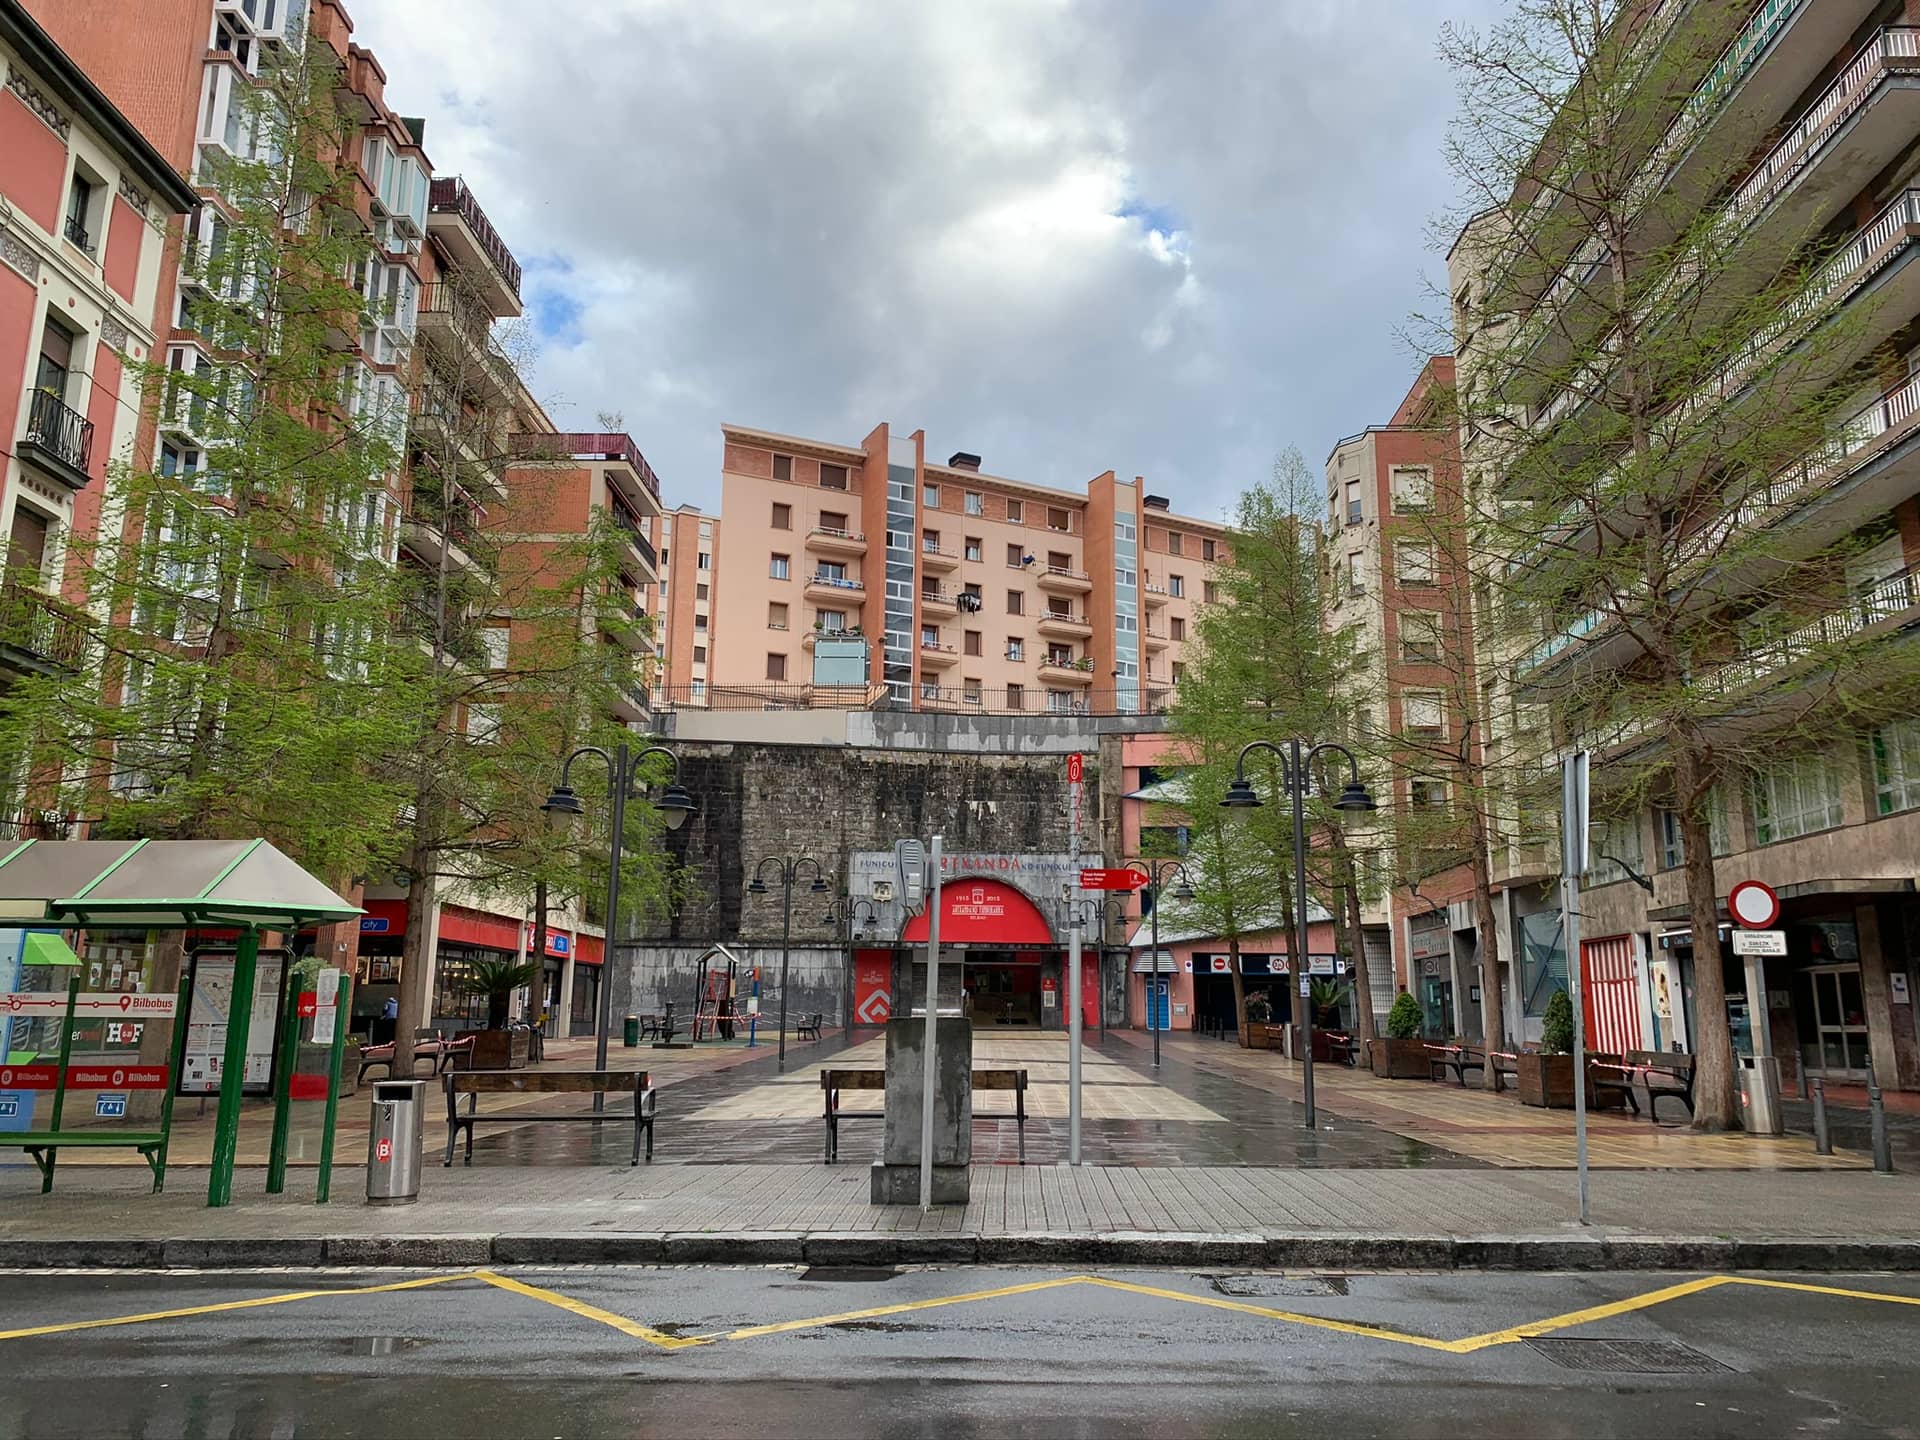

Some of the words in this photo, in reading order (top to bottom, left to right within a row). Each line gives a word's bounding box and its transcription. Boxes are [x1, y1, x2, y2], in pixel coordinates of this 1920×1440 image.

[362, 920, 379, 930] city
[133, 998, 173, 1009] Bilbobus
[76, 1073, 107, 1082] Bilbobus
[128, 1073, 160, 1082] Bilbobus
[380, 1144, 389, 1157] B
